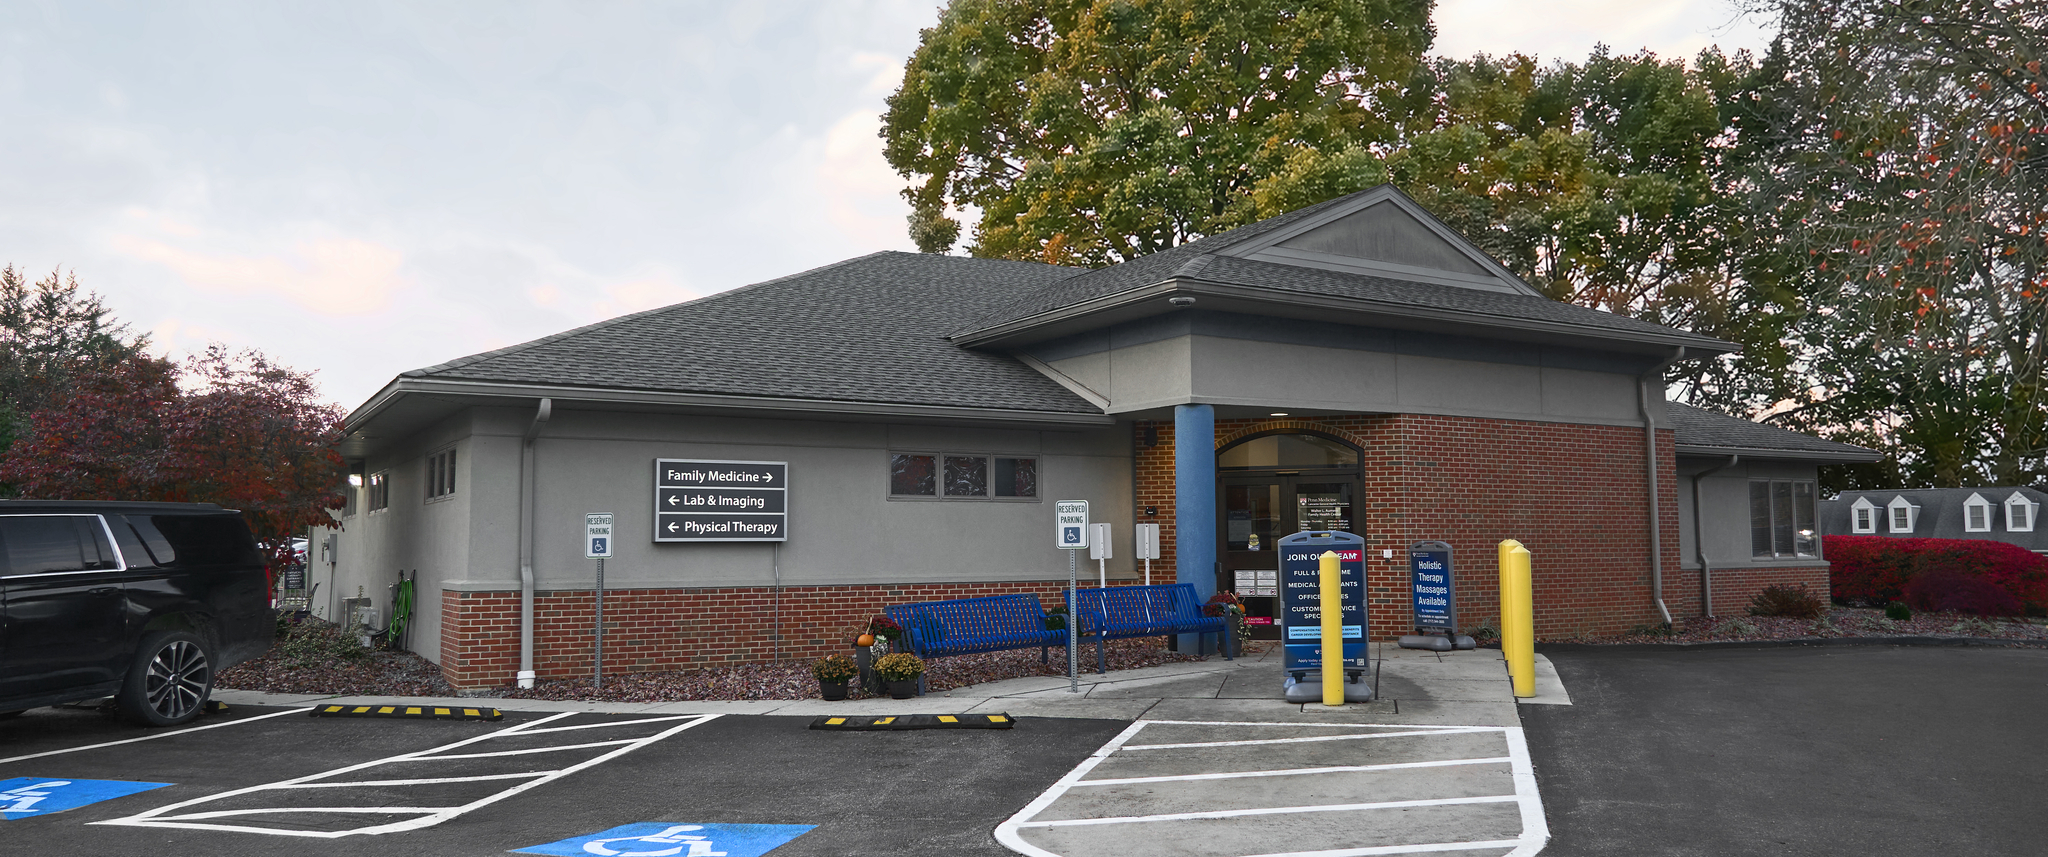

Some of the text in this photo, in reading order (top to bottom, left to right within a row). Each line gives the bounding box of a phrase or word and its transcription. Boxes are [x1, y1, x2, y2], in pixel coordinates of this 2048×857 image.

[668, 470, 759, 483] Family Medicine
[684, 495, 765, 509] Lab & Imaging
[684, 521, 778, 534] Physical Therapy
[1418, 561, 1442, 570] Holistic
[1418, 573, 1443, 583] Therapy
[1416, 584, 1447, 595] Massages
[1418, 596, 1446, 606] Available
